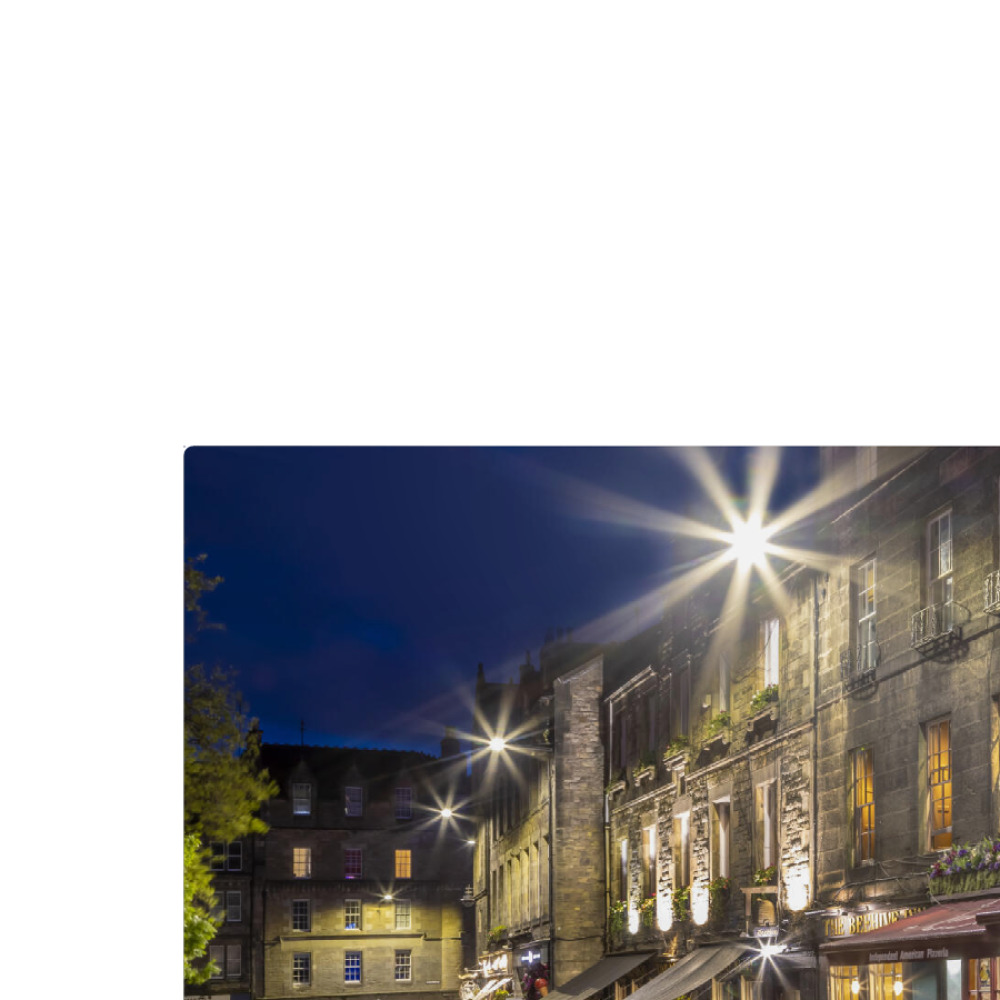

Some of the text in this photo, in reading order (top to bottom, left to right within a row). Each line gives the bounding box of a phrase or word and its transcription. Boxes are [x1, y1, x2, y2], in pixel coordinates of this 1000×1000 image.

[824, 917, 845, 937] THE
[849, 910, 899, 934] BEEHIVE
[869, 947, 949, 962] Independent American Pizzeria
